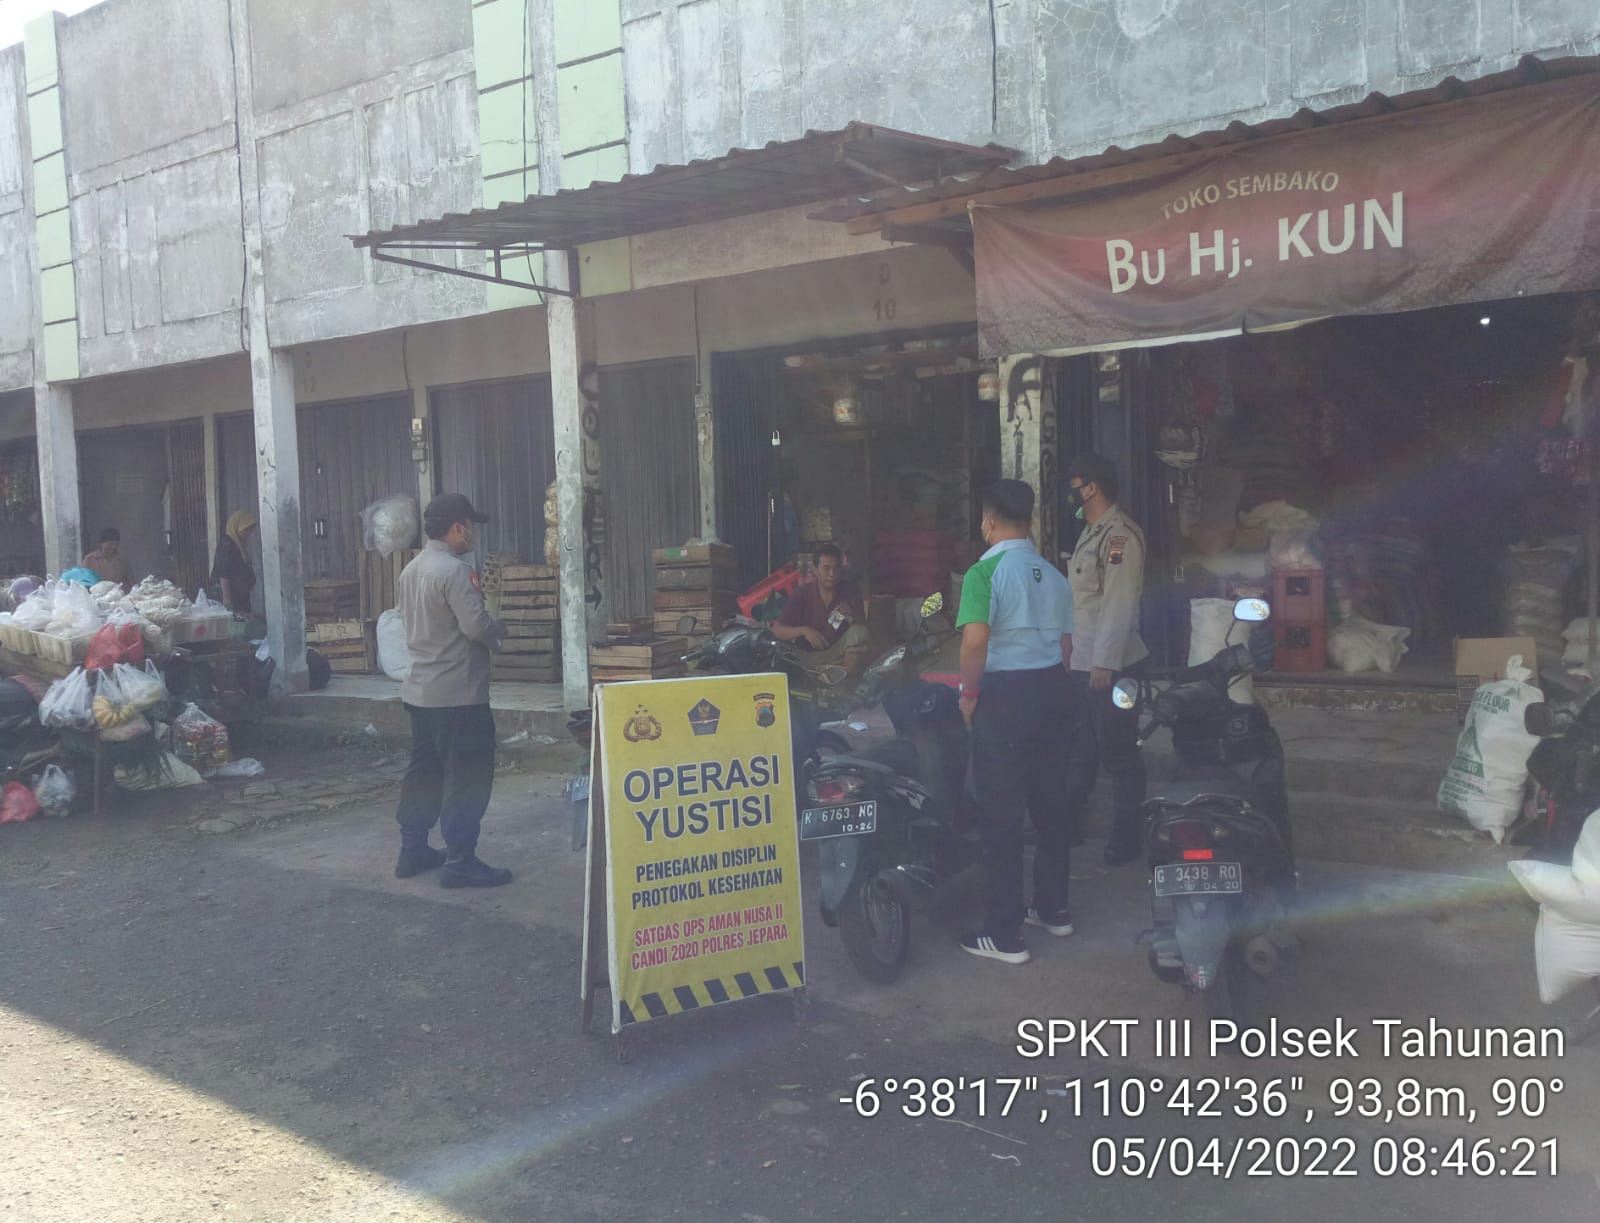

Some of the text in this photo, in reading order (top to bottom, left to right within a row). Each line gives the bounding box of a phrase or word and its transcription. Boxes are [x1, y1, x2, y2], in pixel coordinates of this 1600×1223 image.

[1160, 170, 1340, 220] TOKO SEMBAKO
[1105, 192, 1404, 294] Bu Hj. KUN
[873, 297, 896, 320] 10
[624, 754, 780, 802] OPERASI
[636, 795, 772, 842] YUSTISI
[804, 812, 813, 824] K
[821, 807, 850, 823] 6763
[635, 844, 777, 883] PENEGAKAN DISIPLIN
[1157, 869, 1165, 883] G
[1176, 866, 1209, 881] 3438
[632, 868, 782, 910] PROTOKOL KESEHATAN
[631, 924, 788, 970] CANDI 2020 POLRES JEPARA
[635, 904, 783, 947] SATGAS OPS AMAN NUSA II
